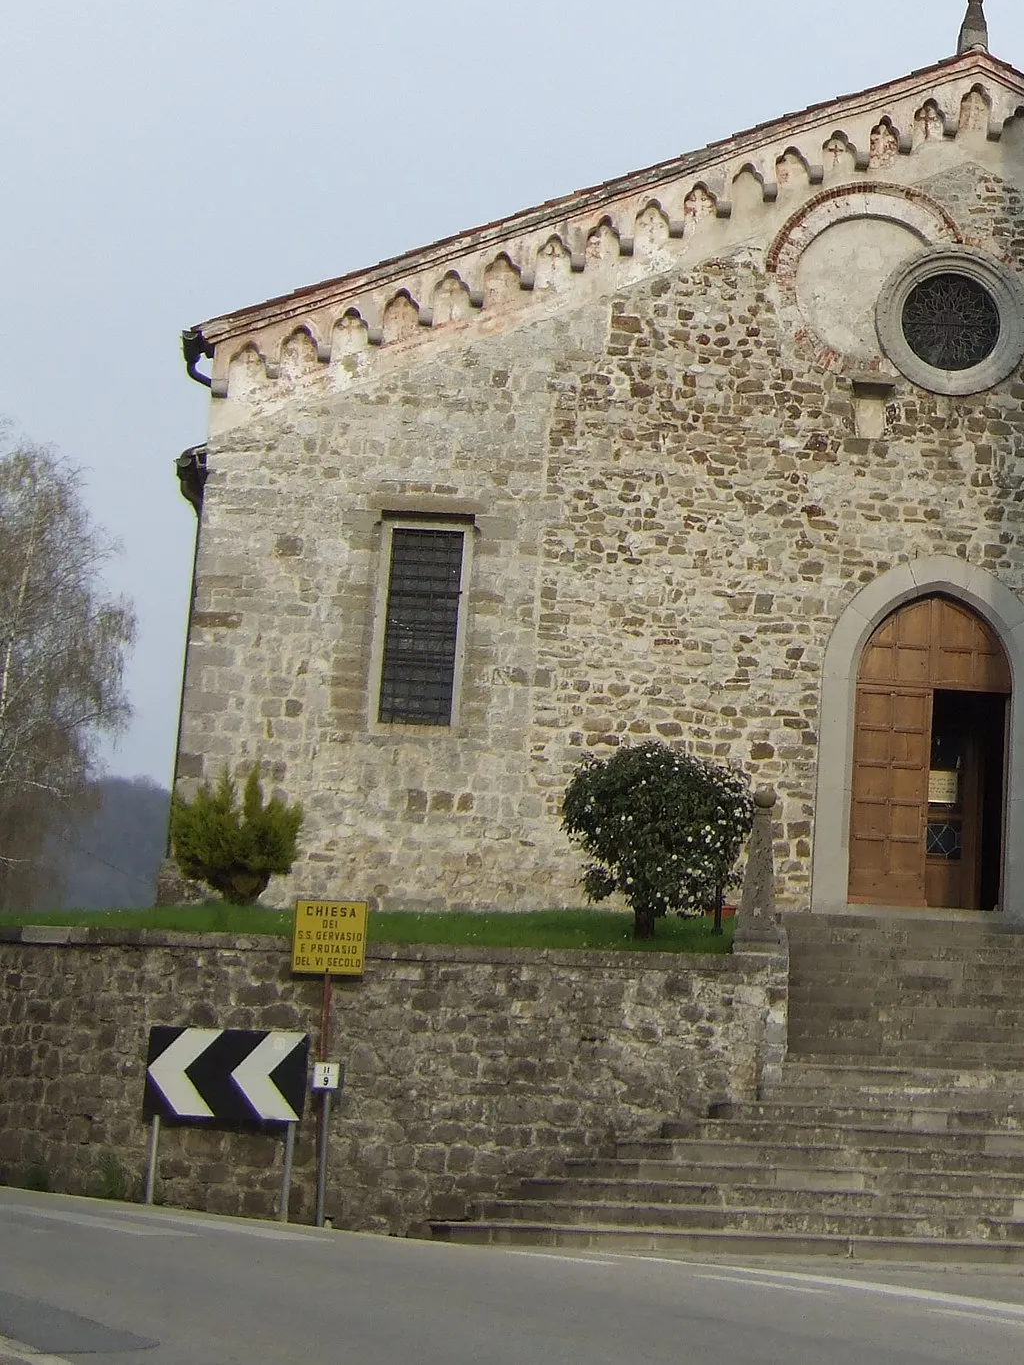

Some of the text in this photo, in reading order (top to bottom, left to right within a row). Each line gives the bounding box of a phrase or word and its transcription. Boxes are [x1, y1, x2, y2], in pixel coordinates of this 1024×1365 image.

[306, 906, 356, 918] CHIESA
[322, 919, 338, 929] DEI
[316, 931, 362, 942] GERVASIO
[300, 943, 357, 955] E PROTASIO
[295, 956, 361, 968] DEL VI SECOLO
[323, 1076, 329, 1086] 9
